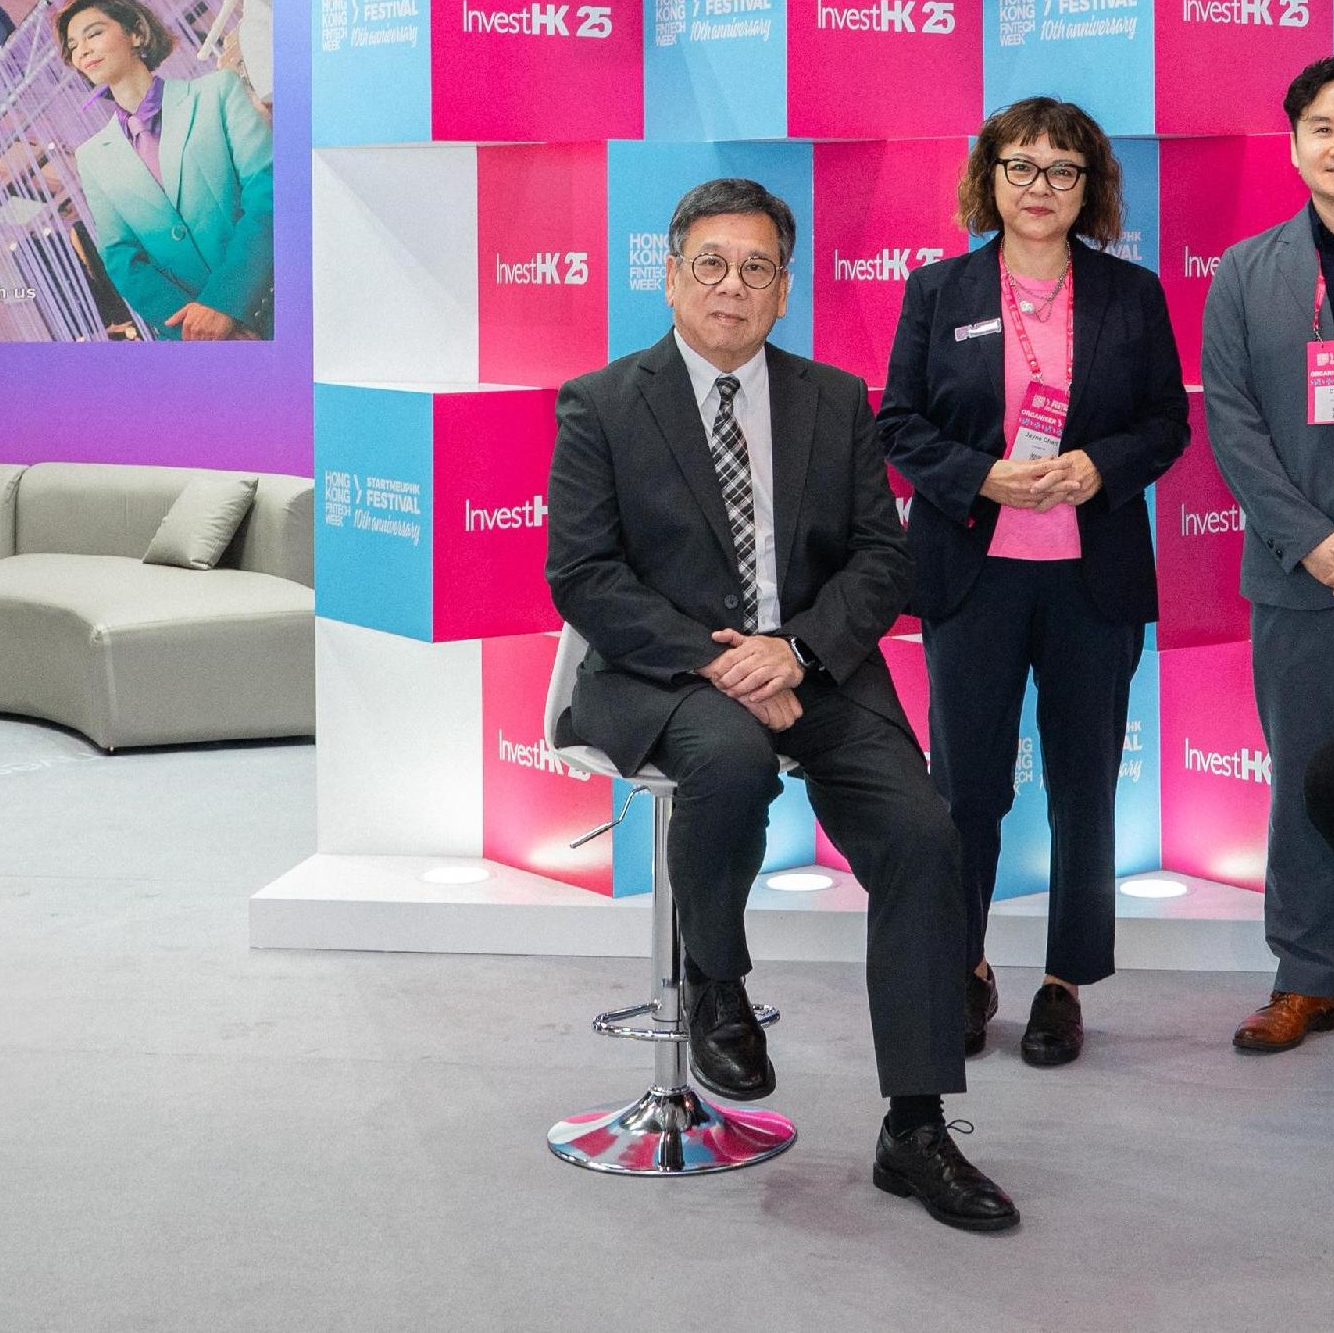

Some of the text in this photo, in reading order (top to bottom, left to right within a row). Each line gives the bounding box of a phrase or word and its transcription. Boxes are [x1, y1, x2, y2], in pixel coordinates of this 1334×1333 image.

[464, 0, 612, 38] InvestHK 25
[922, 1, 955, 34] 25
[1000, 4, 1035, 21] KONG
[497, 252, 588, 284] InvestHK 25
[835, 249, 911, 280] InvestHK
[14, 288, 37, 300] us
